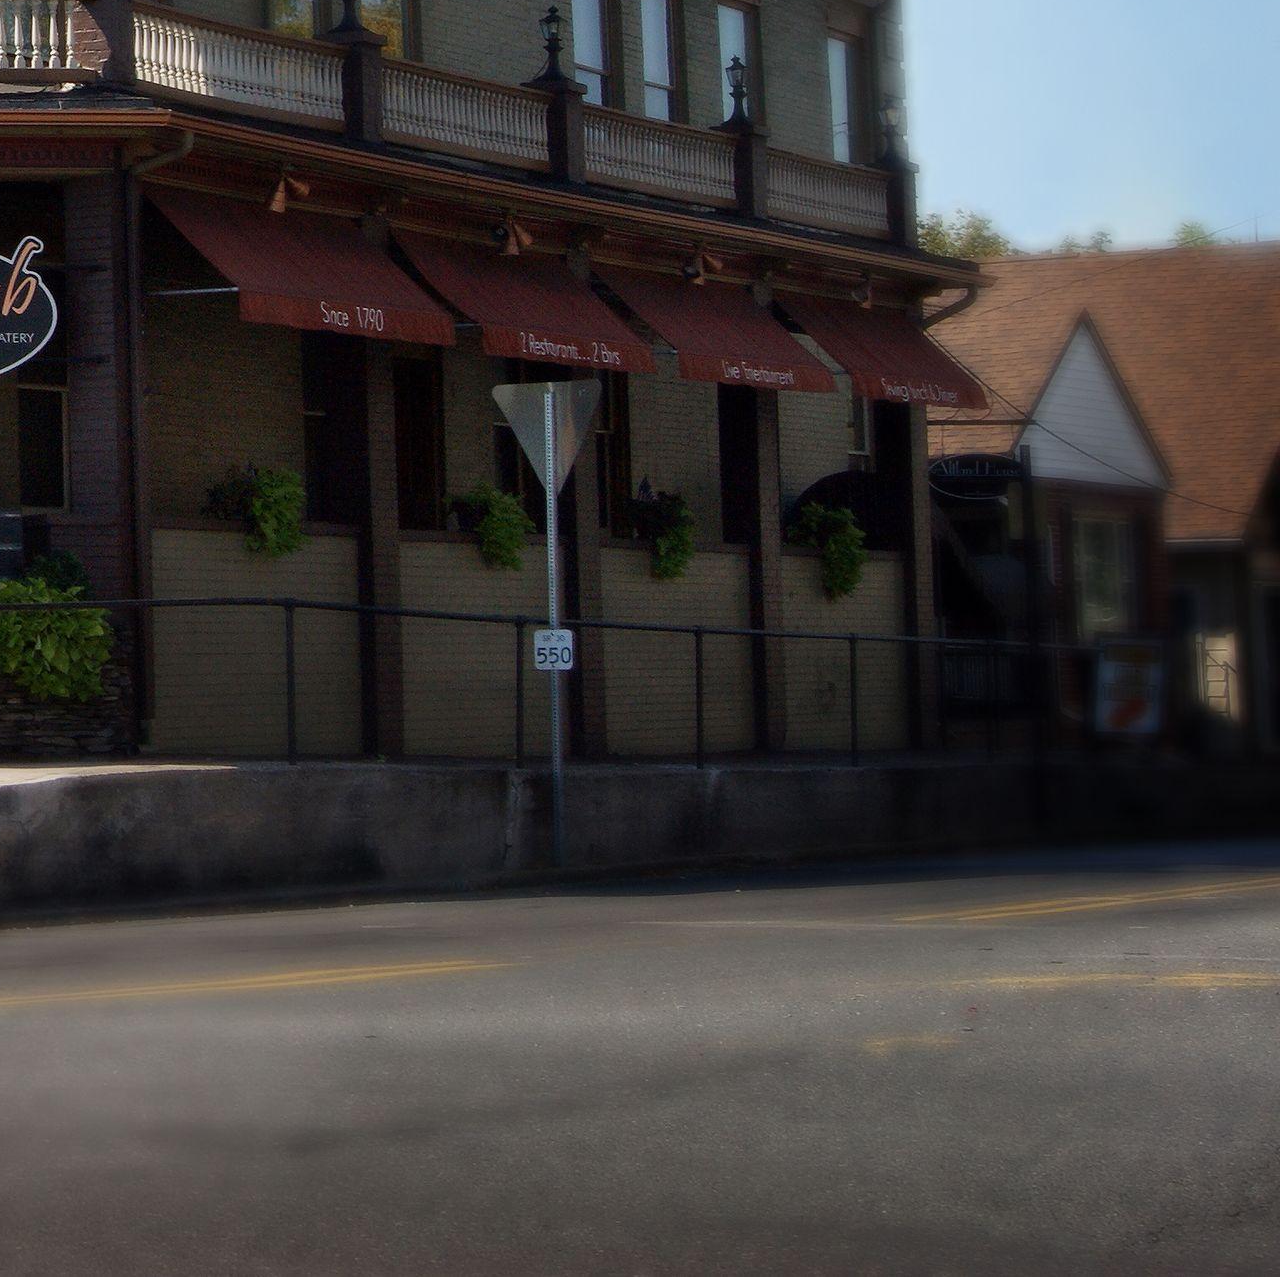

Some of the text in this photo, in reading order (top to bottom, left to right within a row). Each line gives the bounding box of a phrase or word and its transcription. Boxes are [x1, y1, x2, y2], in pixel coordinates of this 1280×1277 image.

[320, 300, 384, 332] Since 1790
[537, 647, 571, 664] 550
